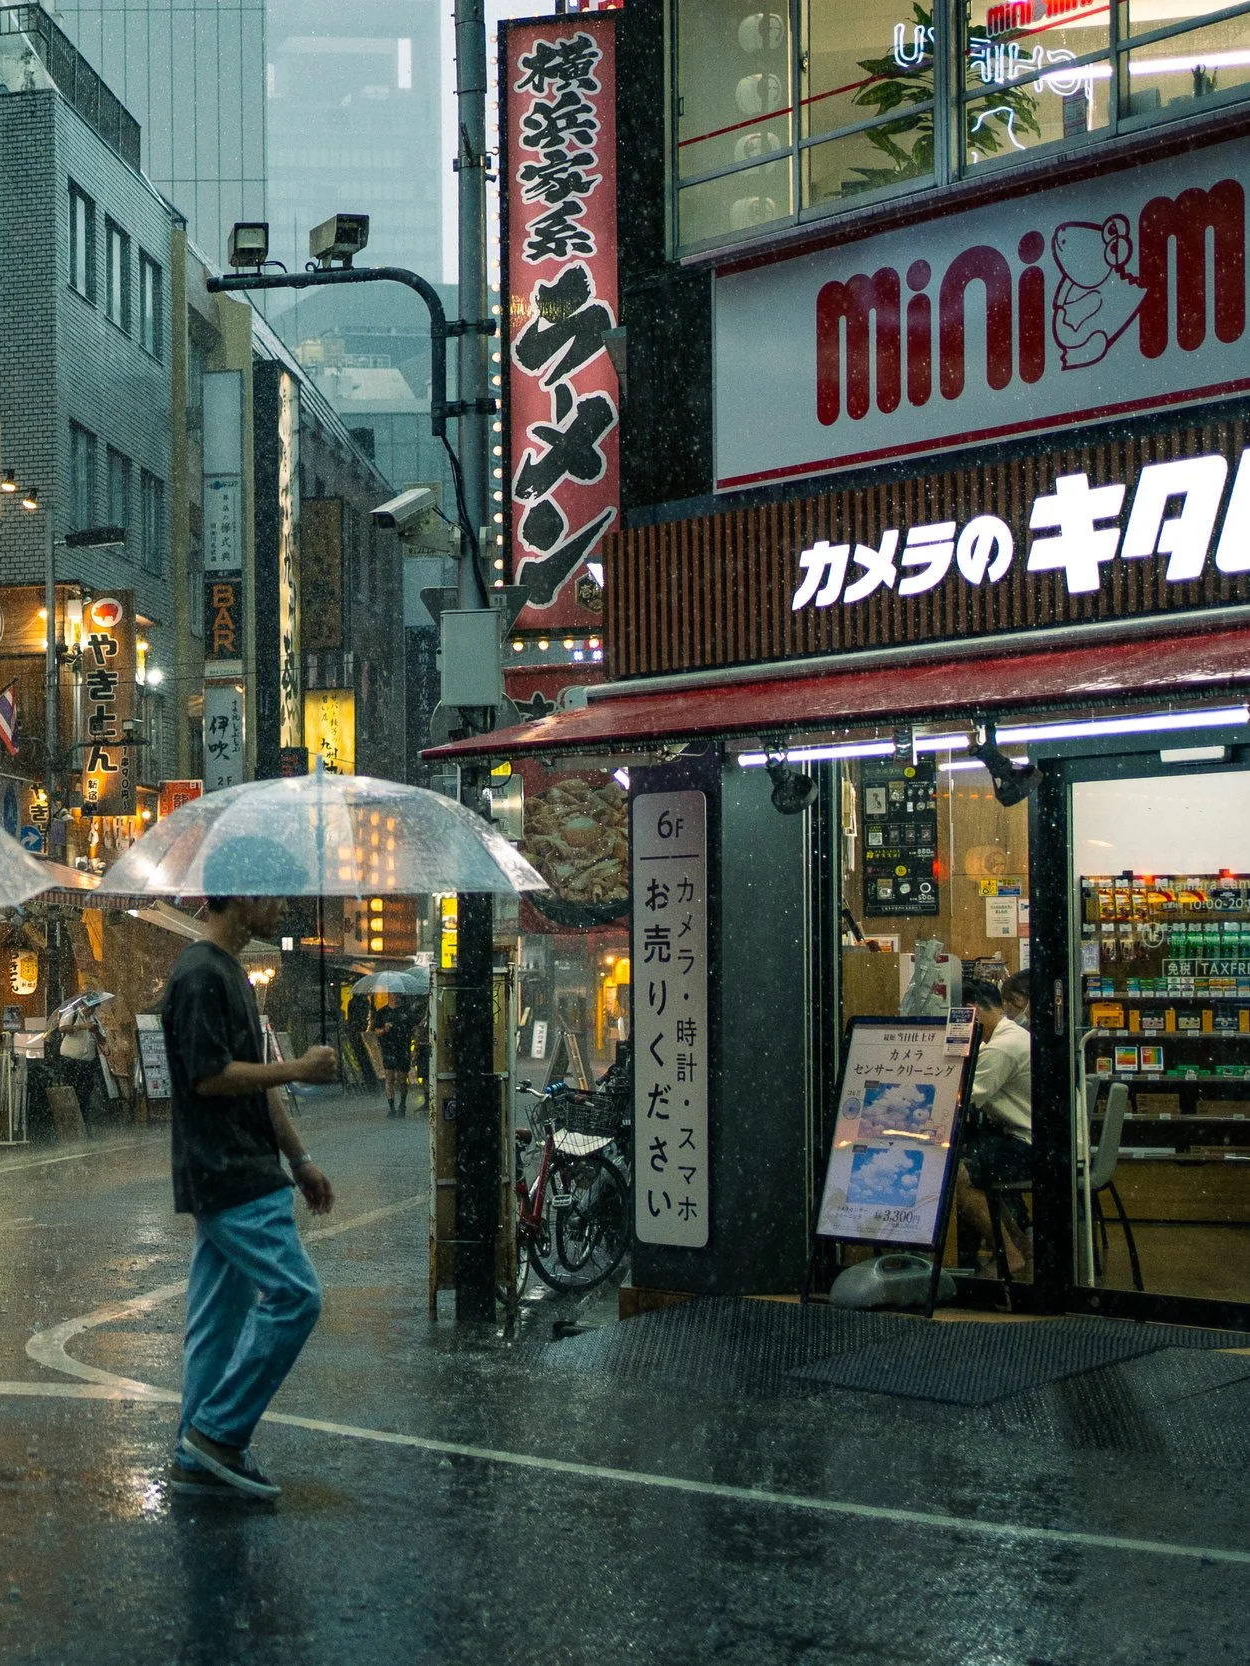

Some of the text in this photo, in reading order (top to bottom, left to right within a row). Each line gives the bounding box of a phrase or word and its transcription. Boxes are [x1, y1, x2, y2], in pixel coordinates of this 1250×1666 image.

[816, 230, 1046, 427] mini
[213, 584, 236, 652] BAR
[86, 633, 119, 773] やきとん
[208, 715, 231, 761] 伊吹
[217, 775, 233, 786] 2F
[657, 811, 685, 840] 6F
[1167, 962, 1191, 976] 免税
[642, 877, 672, 1219] お売りください
[676, 876, 698, 1222] カメラ・時計・スマホ
[853, 1063, 956, 1078] センサークリーニング
[889, 1048, 925, 1062] カメラ
